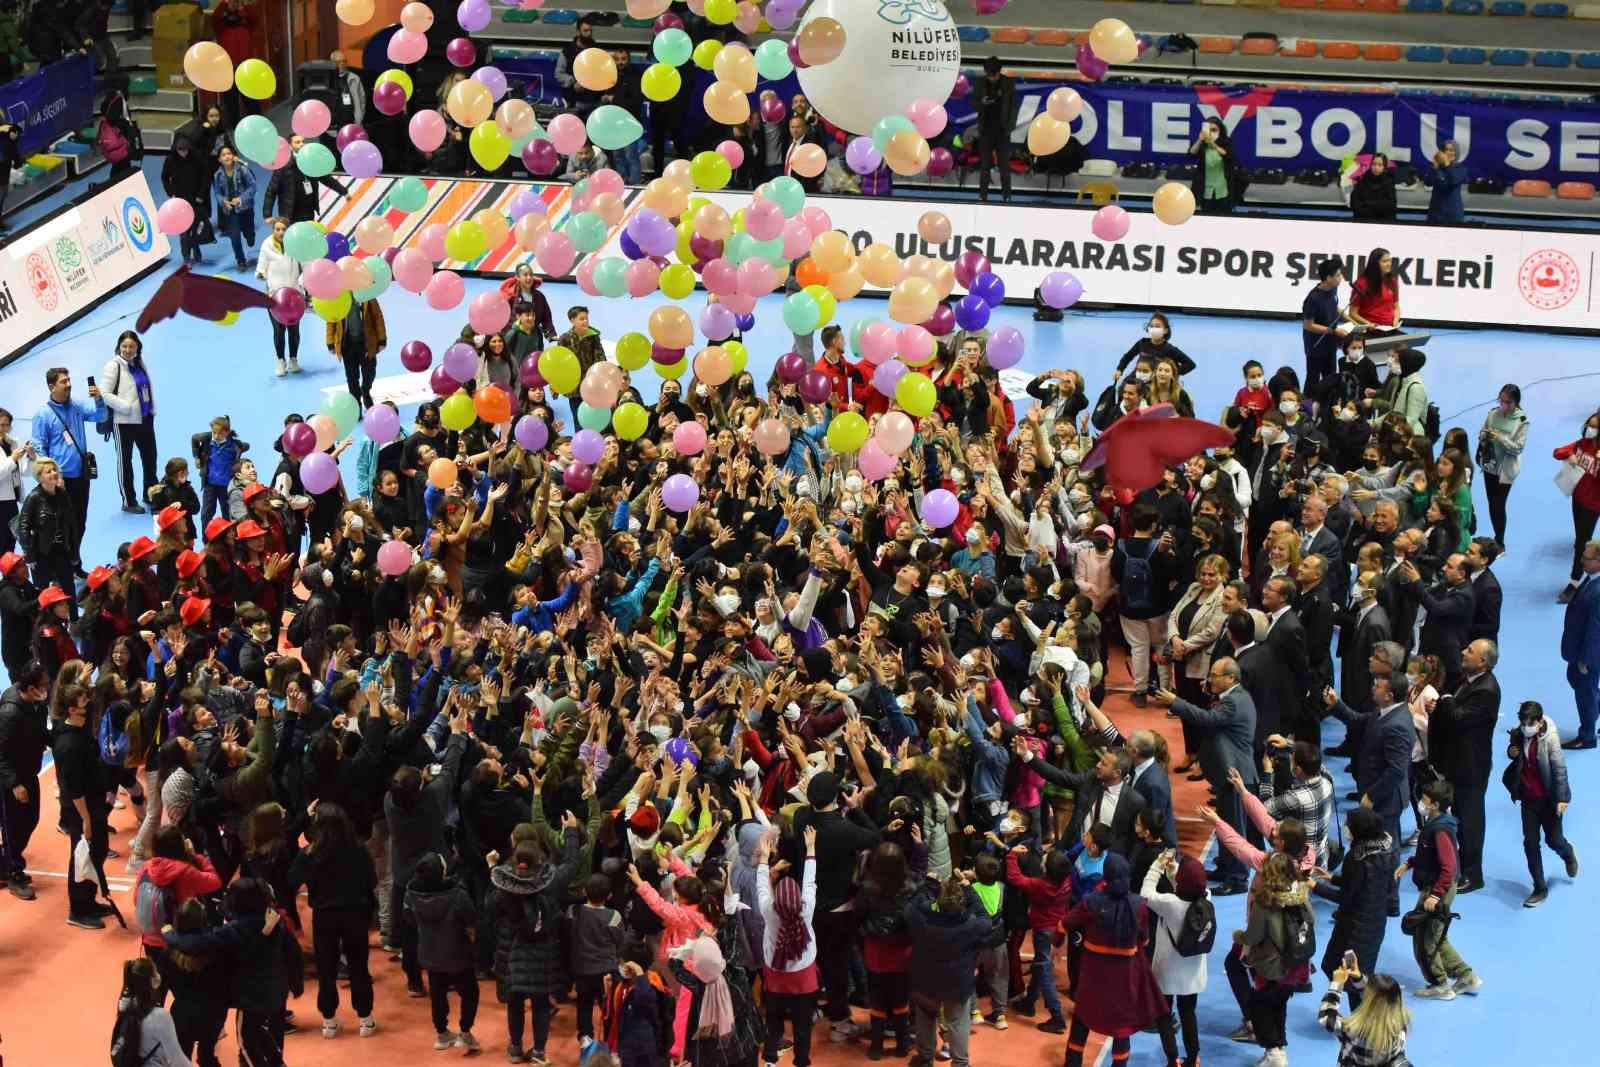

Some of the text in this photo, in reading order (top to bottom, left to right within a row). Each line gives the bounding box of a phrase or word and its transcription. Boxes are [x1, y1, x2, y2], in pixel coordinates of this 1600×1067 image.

[892, 28, 959, 43] NİLÜFER
[1177, 246, 1275, 278] SPOR
[1285, 252, 1494, 289] ŞENKLERİ
